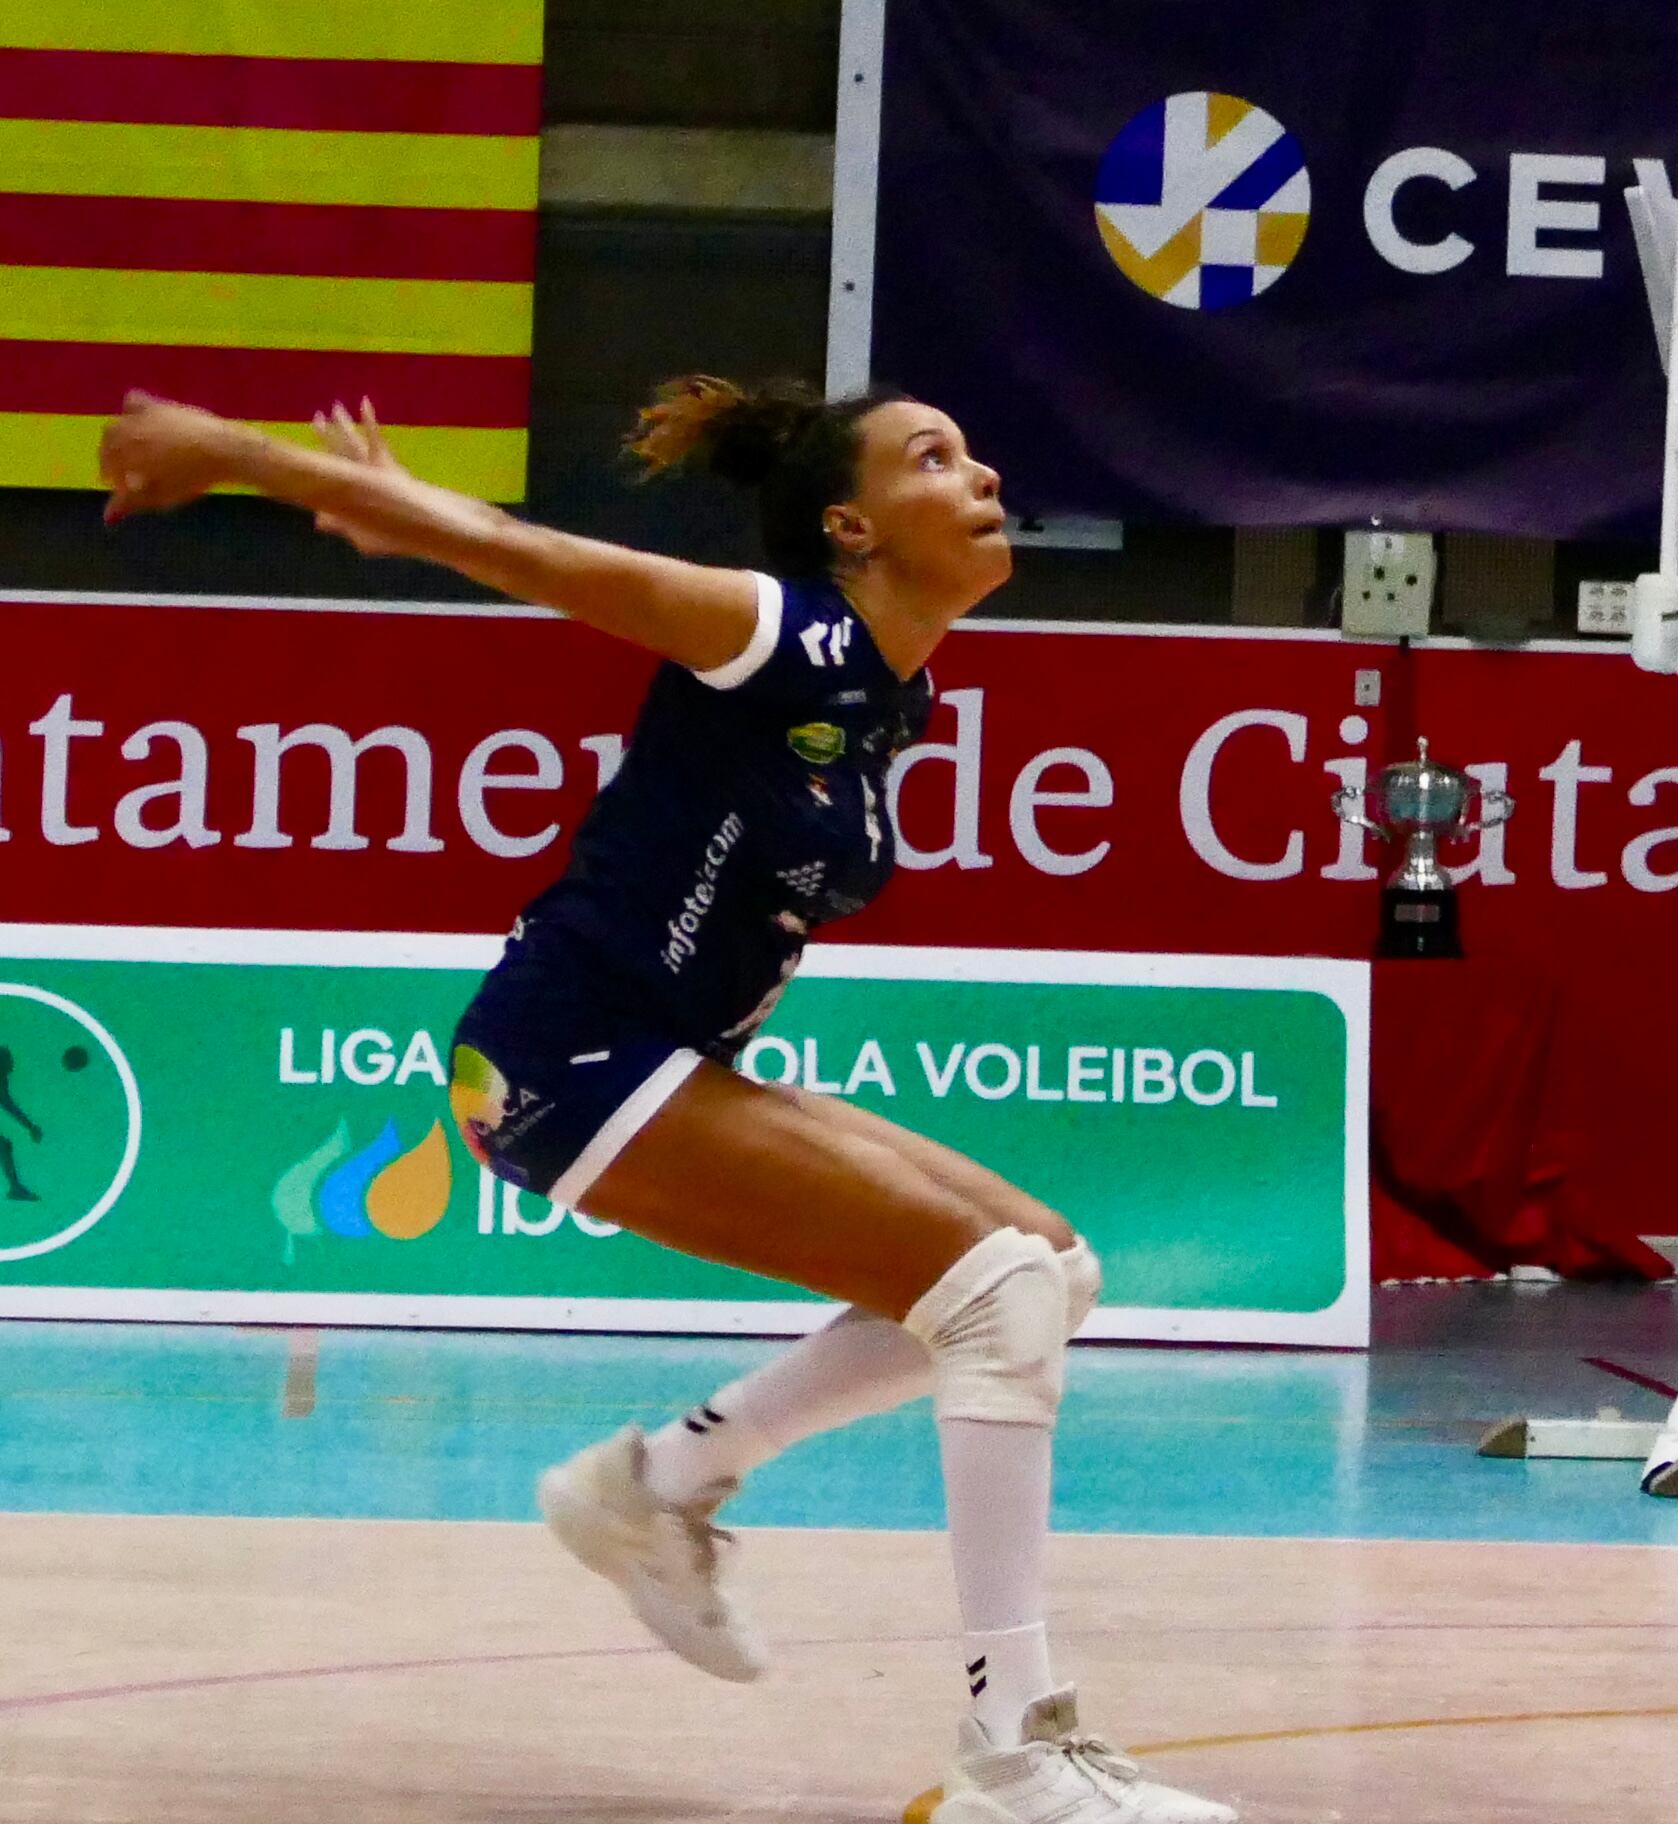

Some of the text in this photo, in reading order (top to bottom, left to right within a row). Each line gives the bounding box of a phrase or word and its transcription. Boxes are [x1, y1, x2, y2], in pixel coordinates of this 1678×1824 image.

[884, 686, 1115, 876] de
[278, 1028, 448, 1086] LIGA
[915, 1041, 1279, 1107] VOLEIBOL
